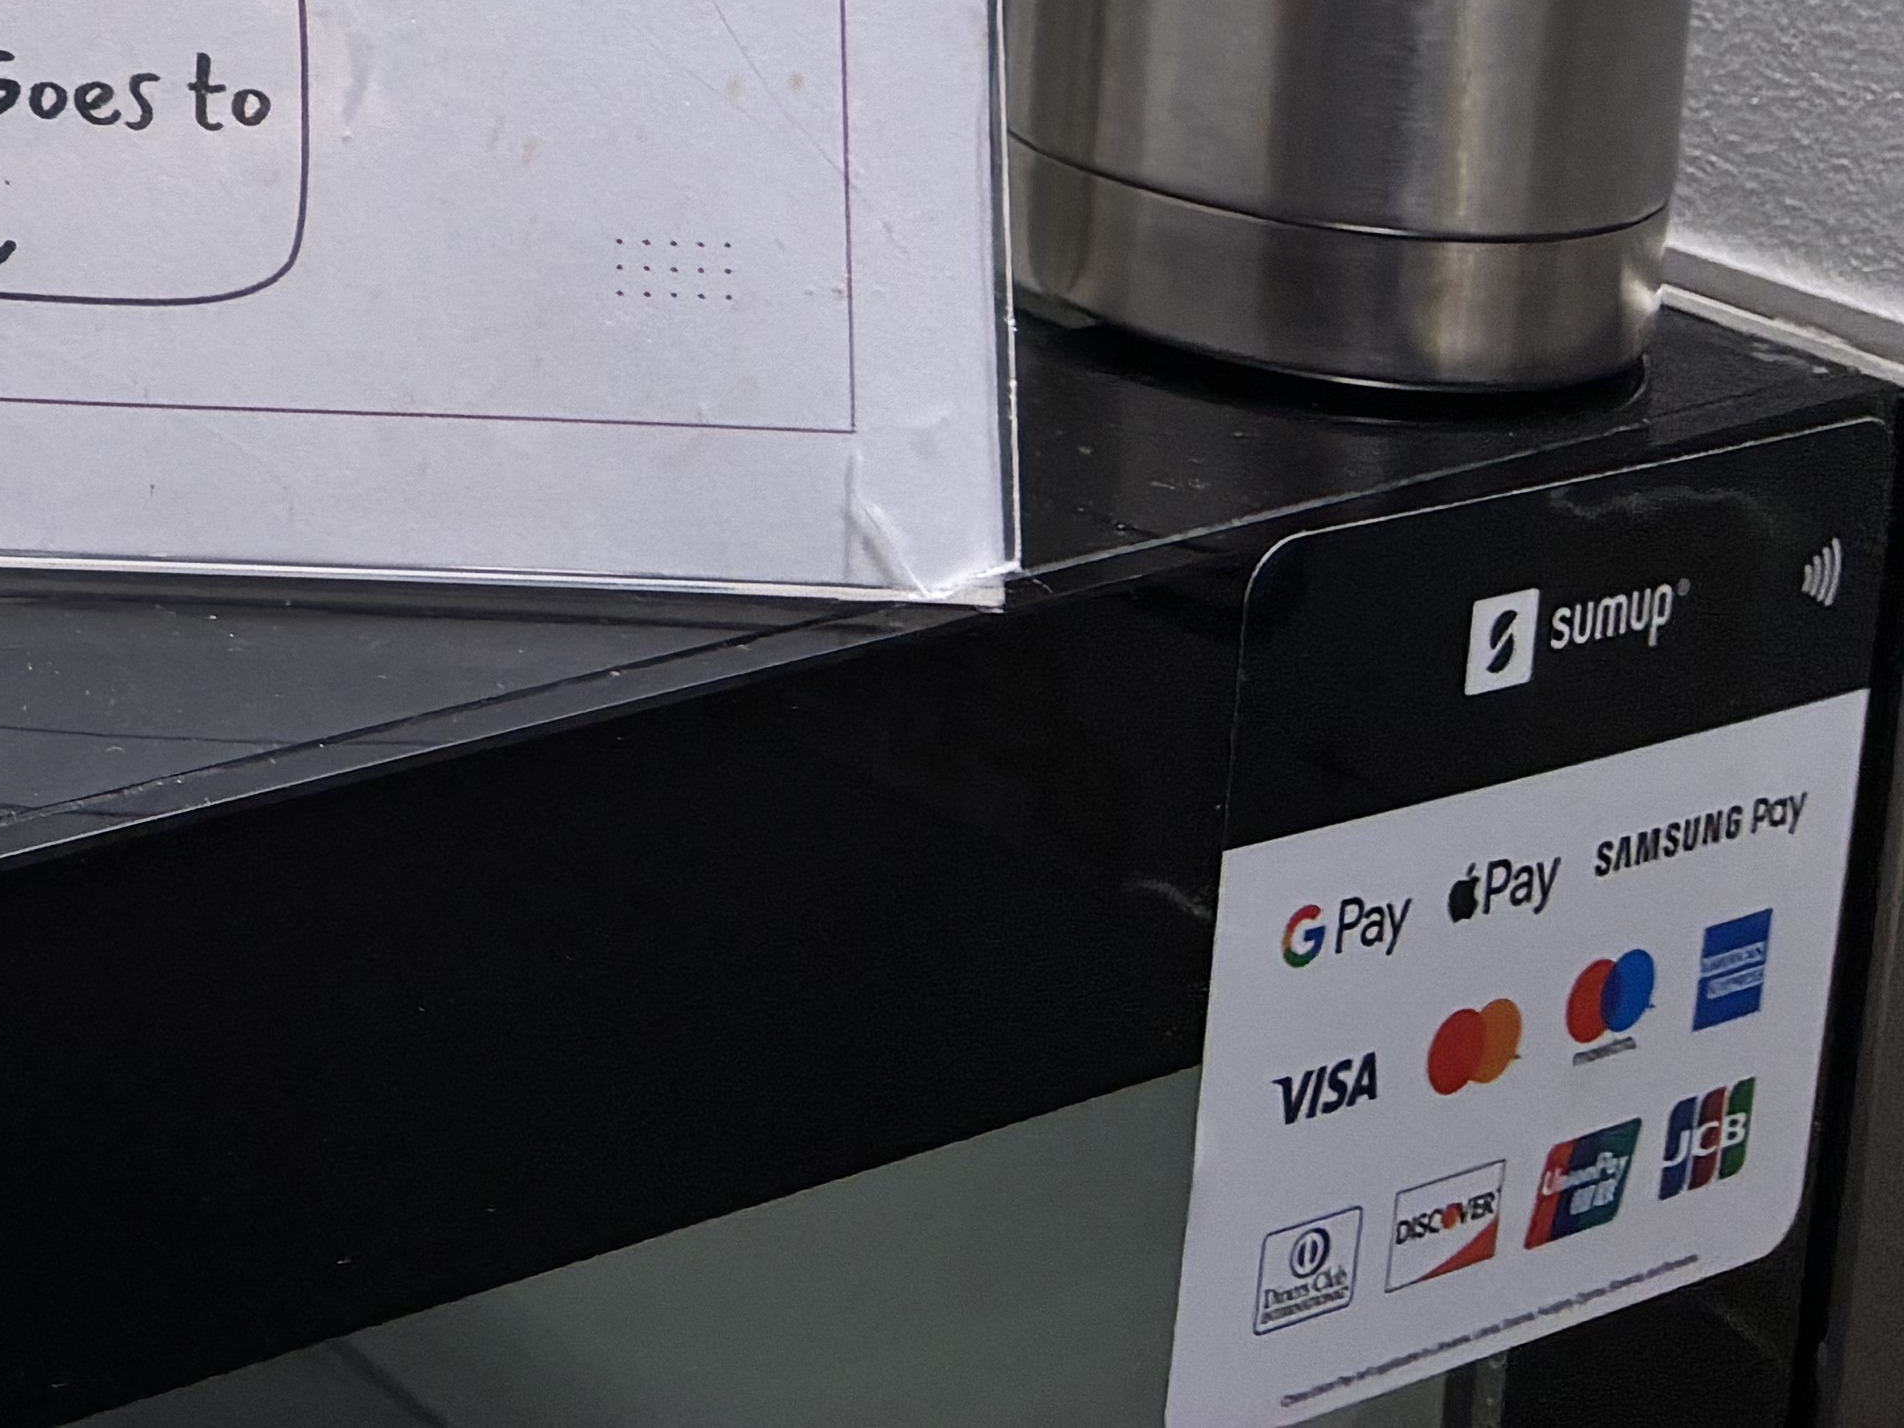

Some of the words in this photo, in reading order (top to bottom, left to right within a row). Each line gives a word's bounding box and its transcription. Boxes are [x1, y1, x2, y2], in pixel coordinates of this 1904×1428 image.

[187, 51, 272, 133] to
[1550, 583, 1674, 649] sumup
[1594, 805, 1745, 879] SAMSUNG
[1750, 791, 1809, 837] Pay
[1481, 856, 1562, 915] Pay
[1334, 897, 1414, 956] Pay
[1272, 1051, 1378, 1126] VISA
[1661, 1111, 1748, 1168] JCB
[1394, 1188, 1499, 1245] DISCOVER
